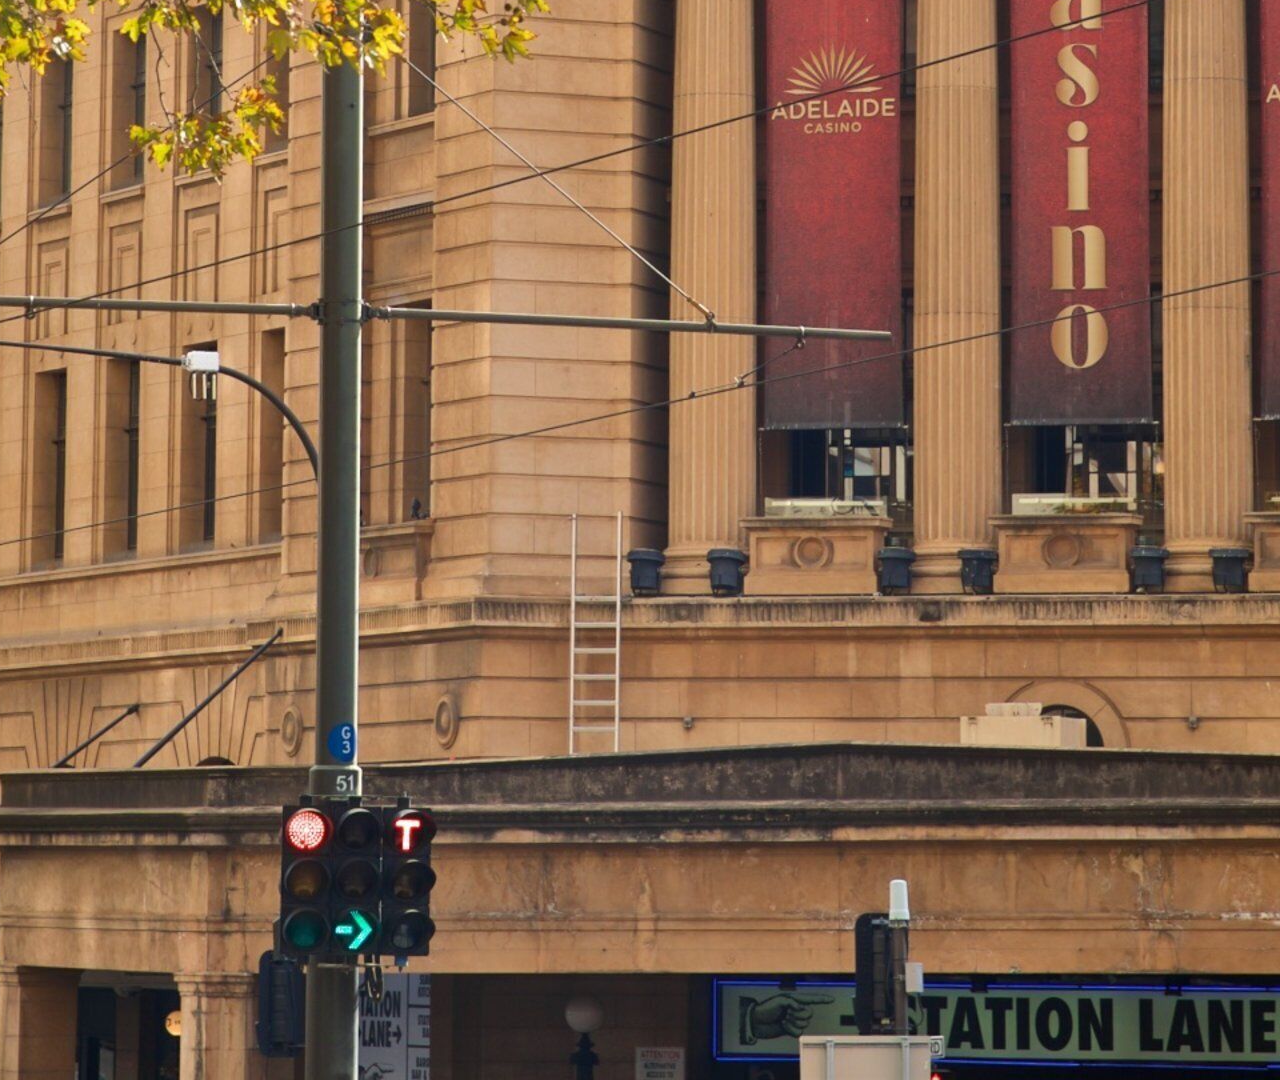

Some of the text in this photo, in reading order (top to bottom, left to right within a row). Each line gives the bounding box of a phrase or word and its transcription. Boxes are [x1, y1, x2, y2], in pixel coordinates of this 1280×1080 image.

[771, 98, 896, 120] ADELAIDE
[803, 122, 863, 134] CASINO
[336, 775, 354, 791] 51
[362, 1020, 392, 1048] LANE
[1139, 998, 1278, 1053] LANE
